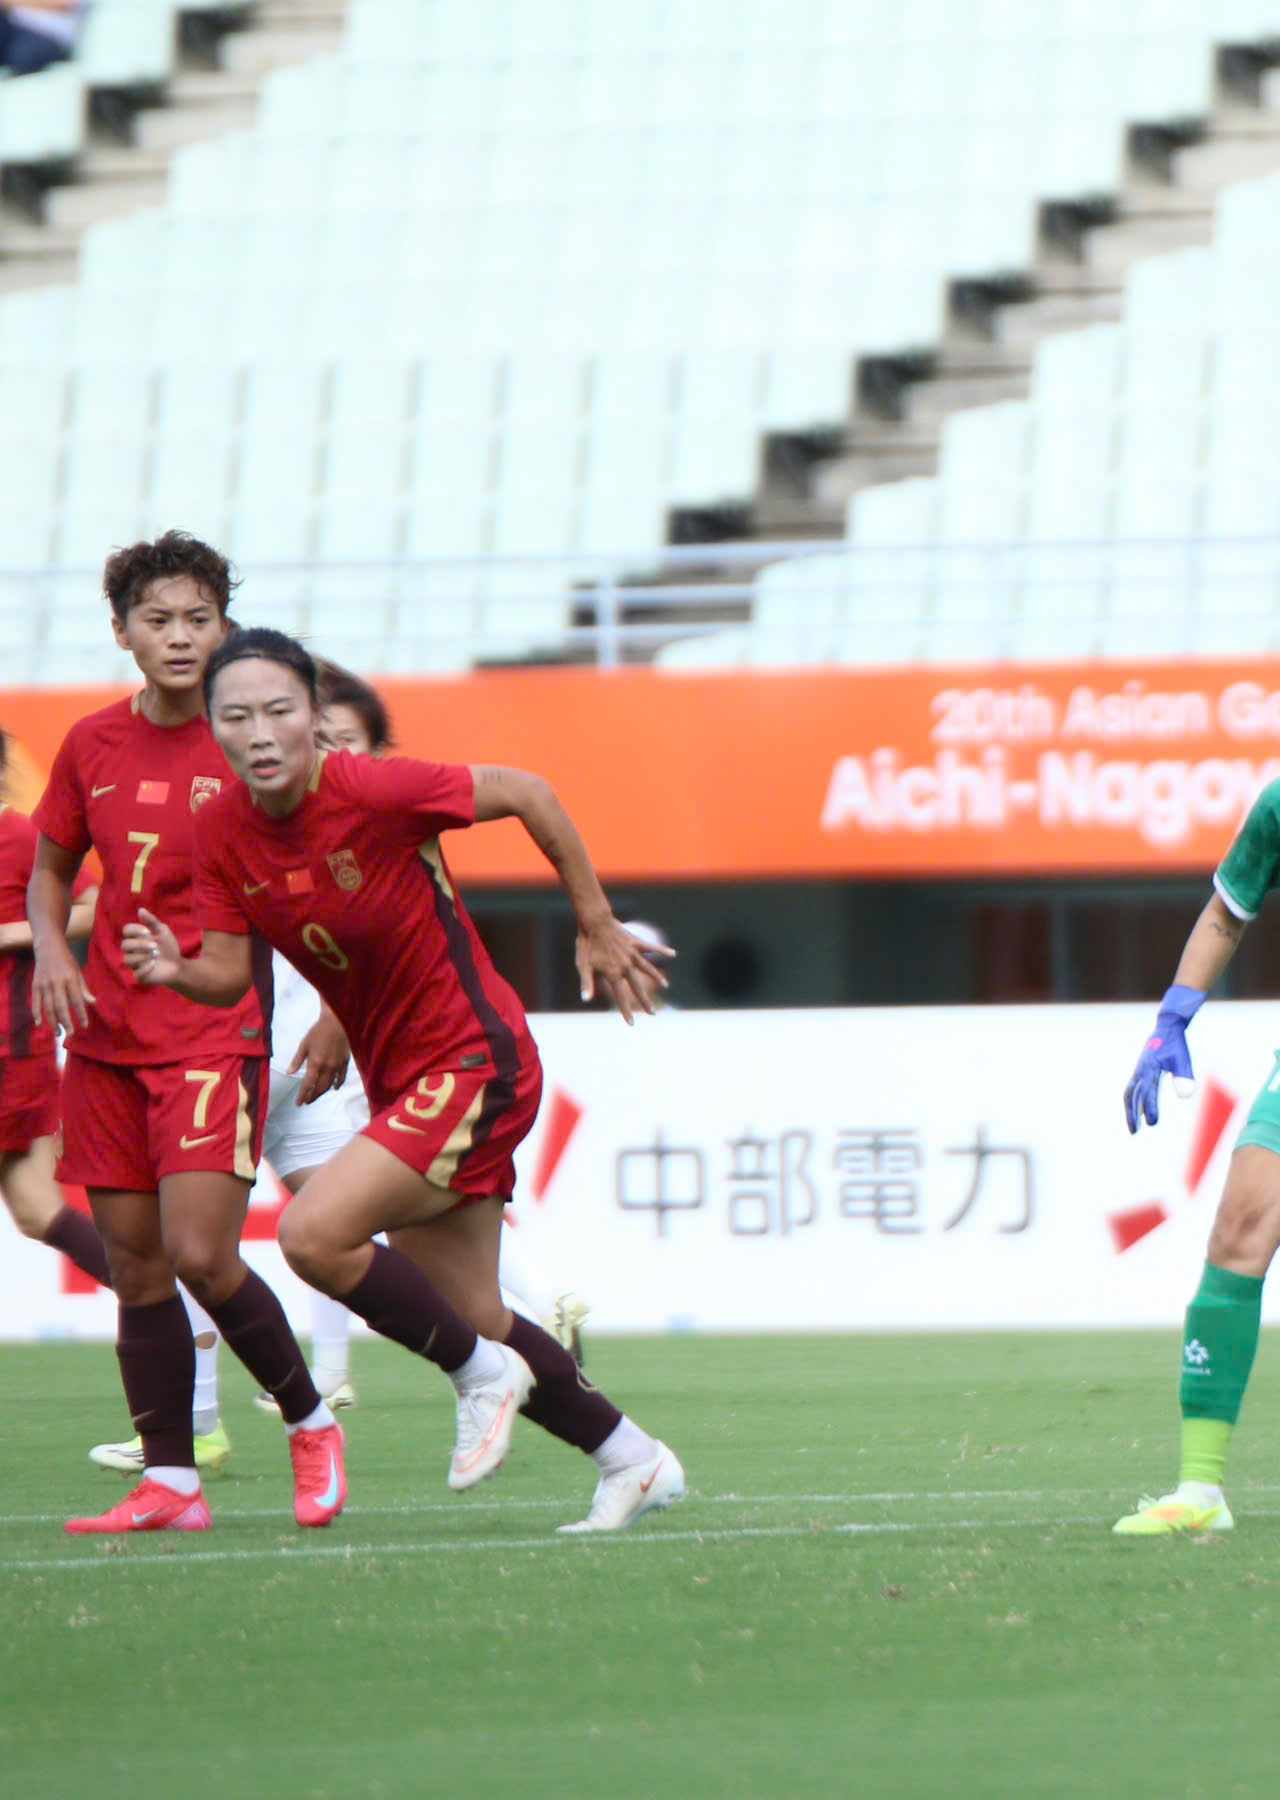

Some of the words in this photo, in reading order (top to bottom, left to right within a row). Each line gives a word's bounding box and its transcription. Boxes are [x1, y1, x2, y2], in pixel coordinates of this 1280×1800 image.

[930, 688, 1055, 743] 20th
[1060, 679, 1209, 743] Asian
[127, 831, 160, 893] 7
[302, 922, 349, 970] 9
[184, 1070, 221, 1129] 7
[404, 1072, 456, 1120] 9
[615, 1124, 1033, 1238] 中部電力
